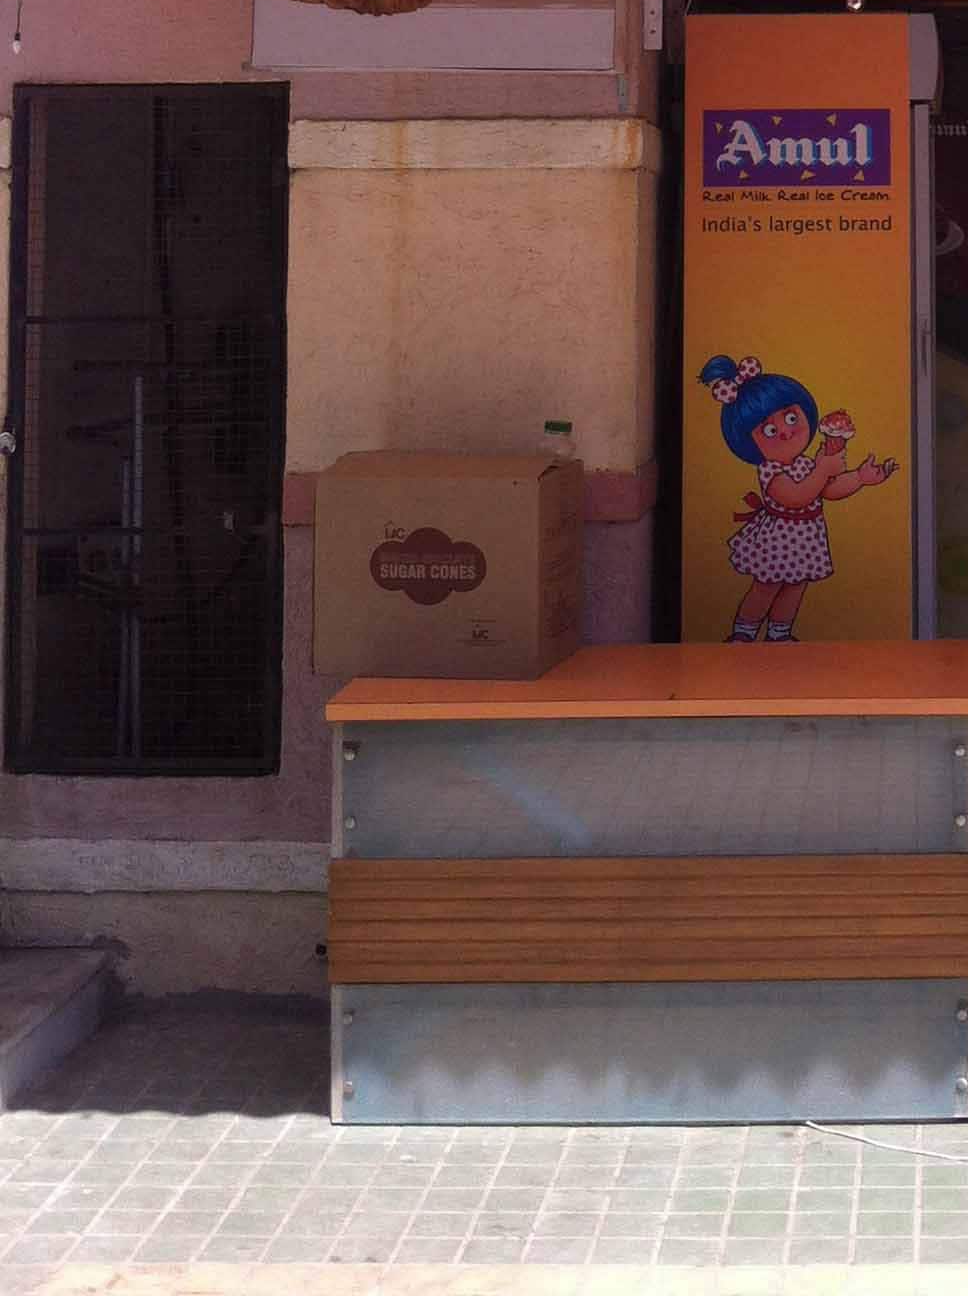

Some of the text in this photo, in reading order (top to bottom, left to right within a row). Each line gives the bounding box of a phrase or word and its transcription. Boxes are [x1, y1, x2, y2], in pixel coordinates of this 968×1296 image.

[716, 119, 872, 172] Amul
[702, 190, 735, 202] Real
[777, 190, 810, 202] Real
[815, 190, 835, 201] Ice
[702, 215, 892, 235] India's largest brand
[379, 562, 477, 580] SUGAR CONES
